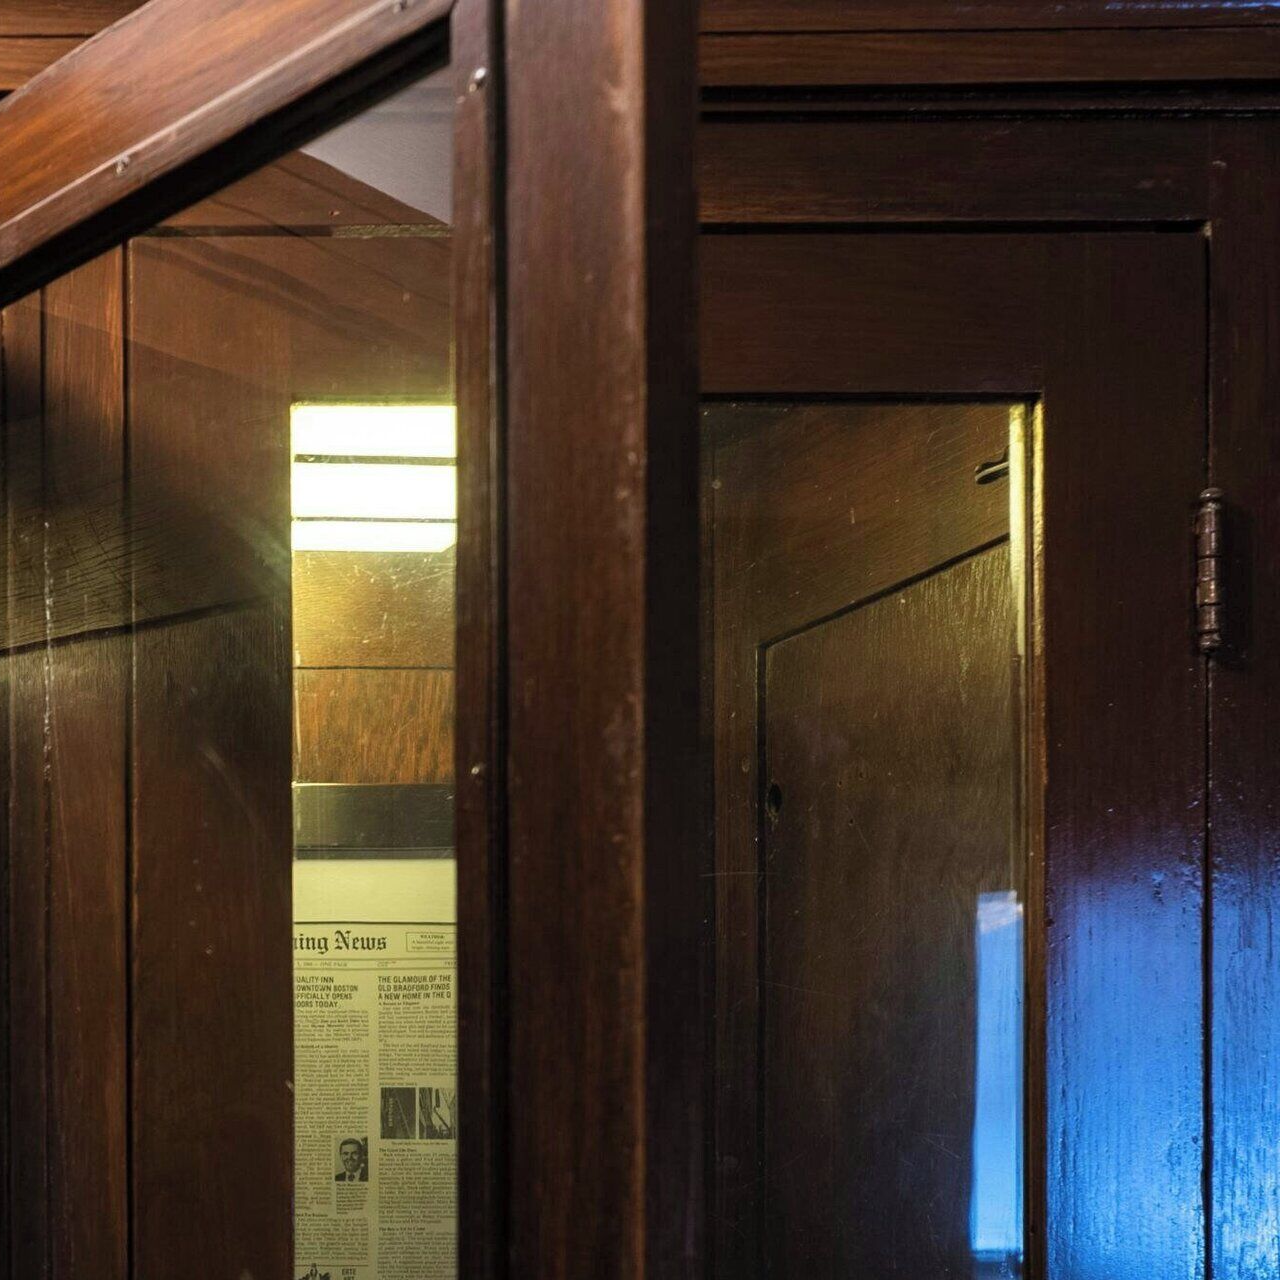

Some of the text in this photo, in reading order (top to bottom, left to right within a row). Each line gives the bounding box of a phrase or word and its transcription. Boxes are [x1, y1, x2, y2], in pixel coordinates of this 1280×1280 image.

[335, 930, 387, 951] News
[321, 976, 334, 984] INN
[393, 975, 428, 983] GLAMOUR
[429, 975, 437, 983] OF
[378, 984, 392, 992] OLD
[430, 983, 450, 991] FINDS
[402, 992, 421, 1000] HOME
[432, 991, 445, 999] THE
